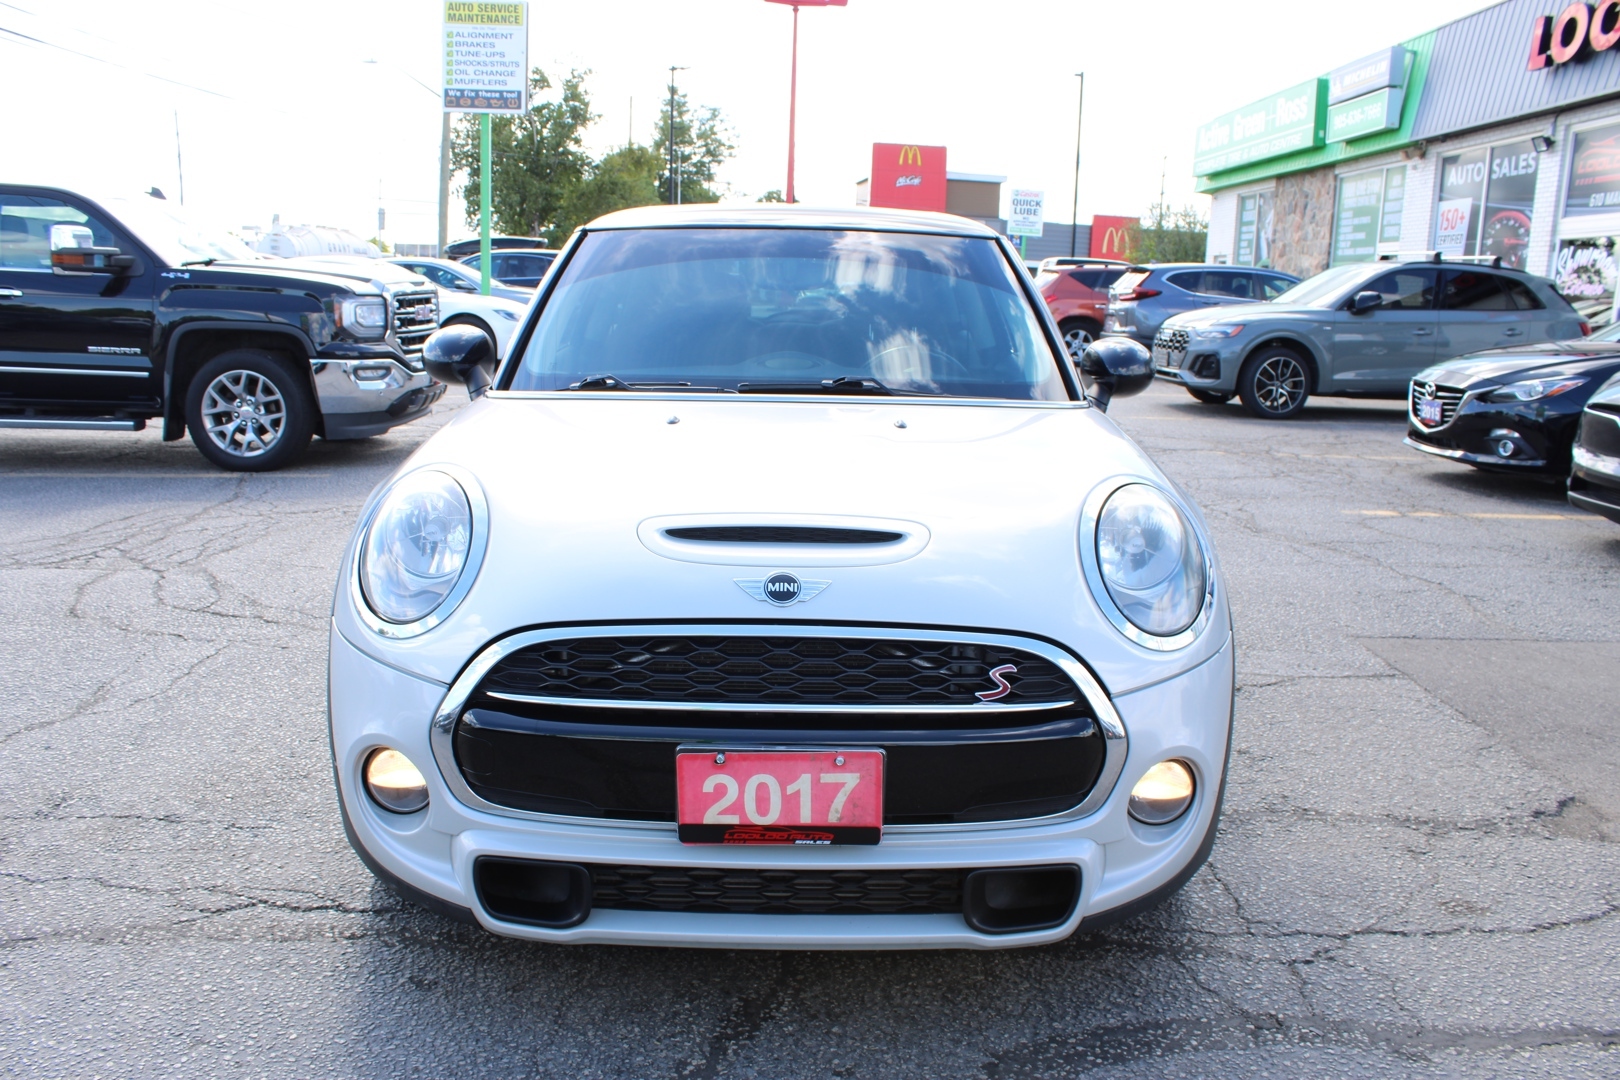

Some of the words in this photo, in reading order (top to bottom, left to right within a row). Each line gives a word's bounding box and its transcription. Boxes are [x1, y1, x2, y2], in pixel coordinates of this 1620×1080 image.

[448, 2, 474, 12] AUTO
[477, 3, 519, 14] SERVICE
[448, 12, 520, 24] MAINTENANCE
[455, 31, 514, 40] ALIGNMENT
[455, 40, 495, 49] BRAKES
[455, 50, 505, 58] TUNE-UPS
[454, 59, 520, 68] SHOCKS/STRUTS
[454, 68, 470, 76] OIL
[473, 69, 516, 77] CHANGE
[1343, 60, 1388, 88] MICHELIN
[454, 78, 508, 86] MUFFLERS
[447, 89, 461, 97] We
[478, 90, 500, 98] these
[1197, 118, 1230, 153] Active
[1232, 109, 1266, 142] Green
[1275, 95, 1308, 128] Ross
[1196, 155, 1227, 173] COMPLETE
[1227, 150, 1243, 164] TIRE
[1249, 143, 1270, 157] AUTO
[1270, 132, 1303, 151] CENTRE
[1447, 161, 1485, 186] AUTO
[1491, 152, 1537, 180] SALES
[1012, 198, 1042, 208] QUICK
[1589, 192, 1605, 208] 610
[1013, 207, 1039, 216] LUBE
[1439, 208, 1466, 231] 150+
[1437, 233, 1464, 246] CERTIFIED
[87, 346, 141, 355] SIERRA
[1422, 404, 1440, 421] 2015
[767, 582, 798, 593] MINI
[975, 664, 1017, 701] S
[702, 773, 861, 826] 2017
